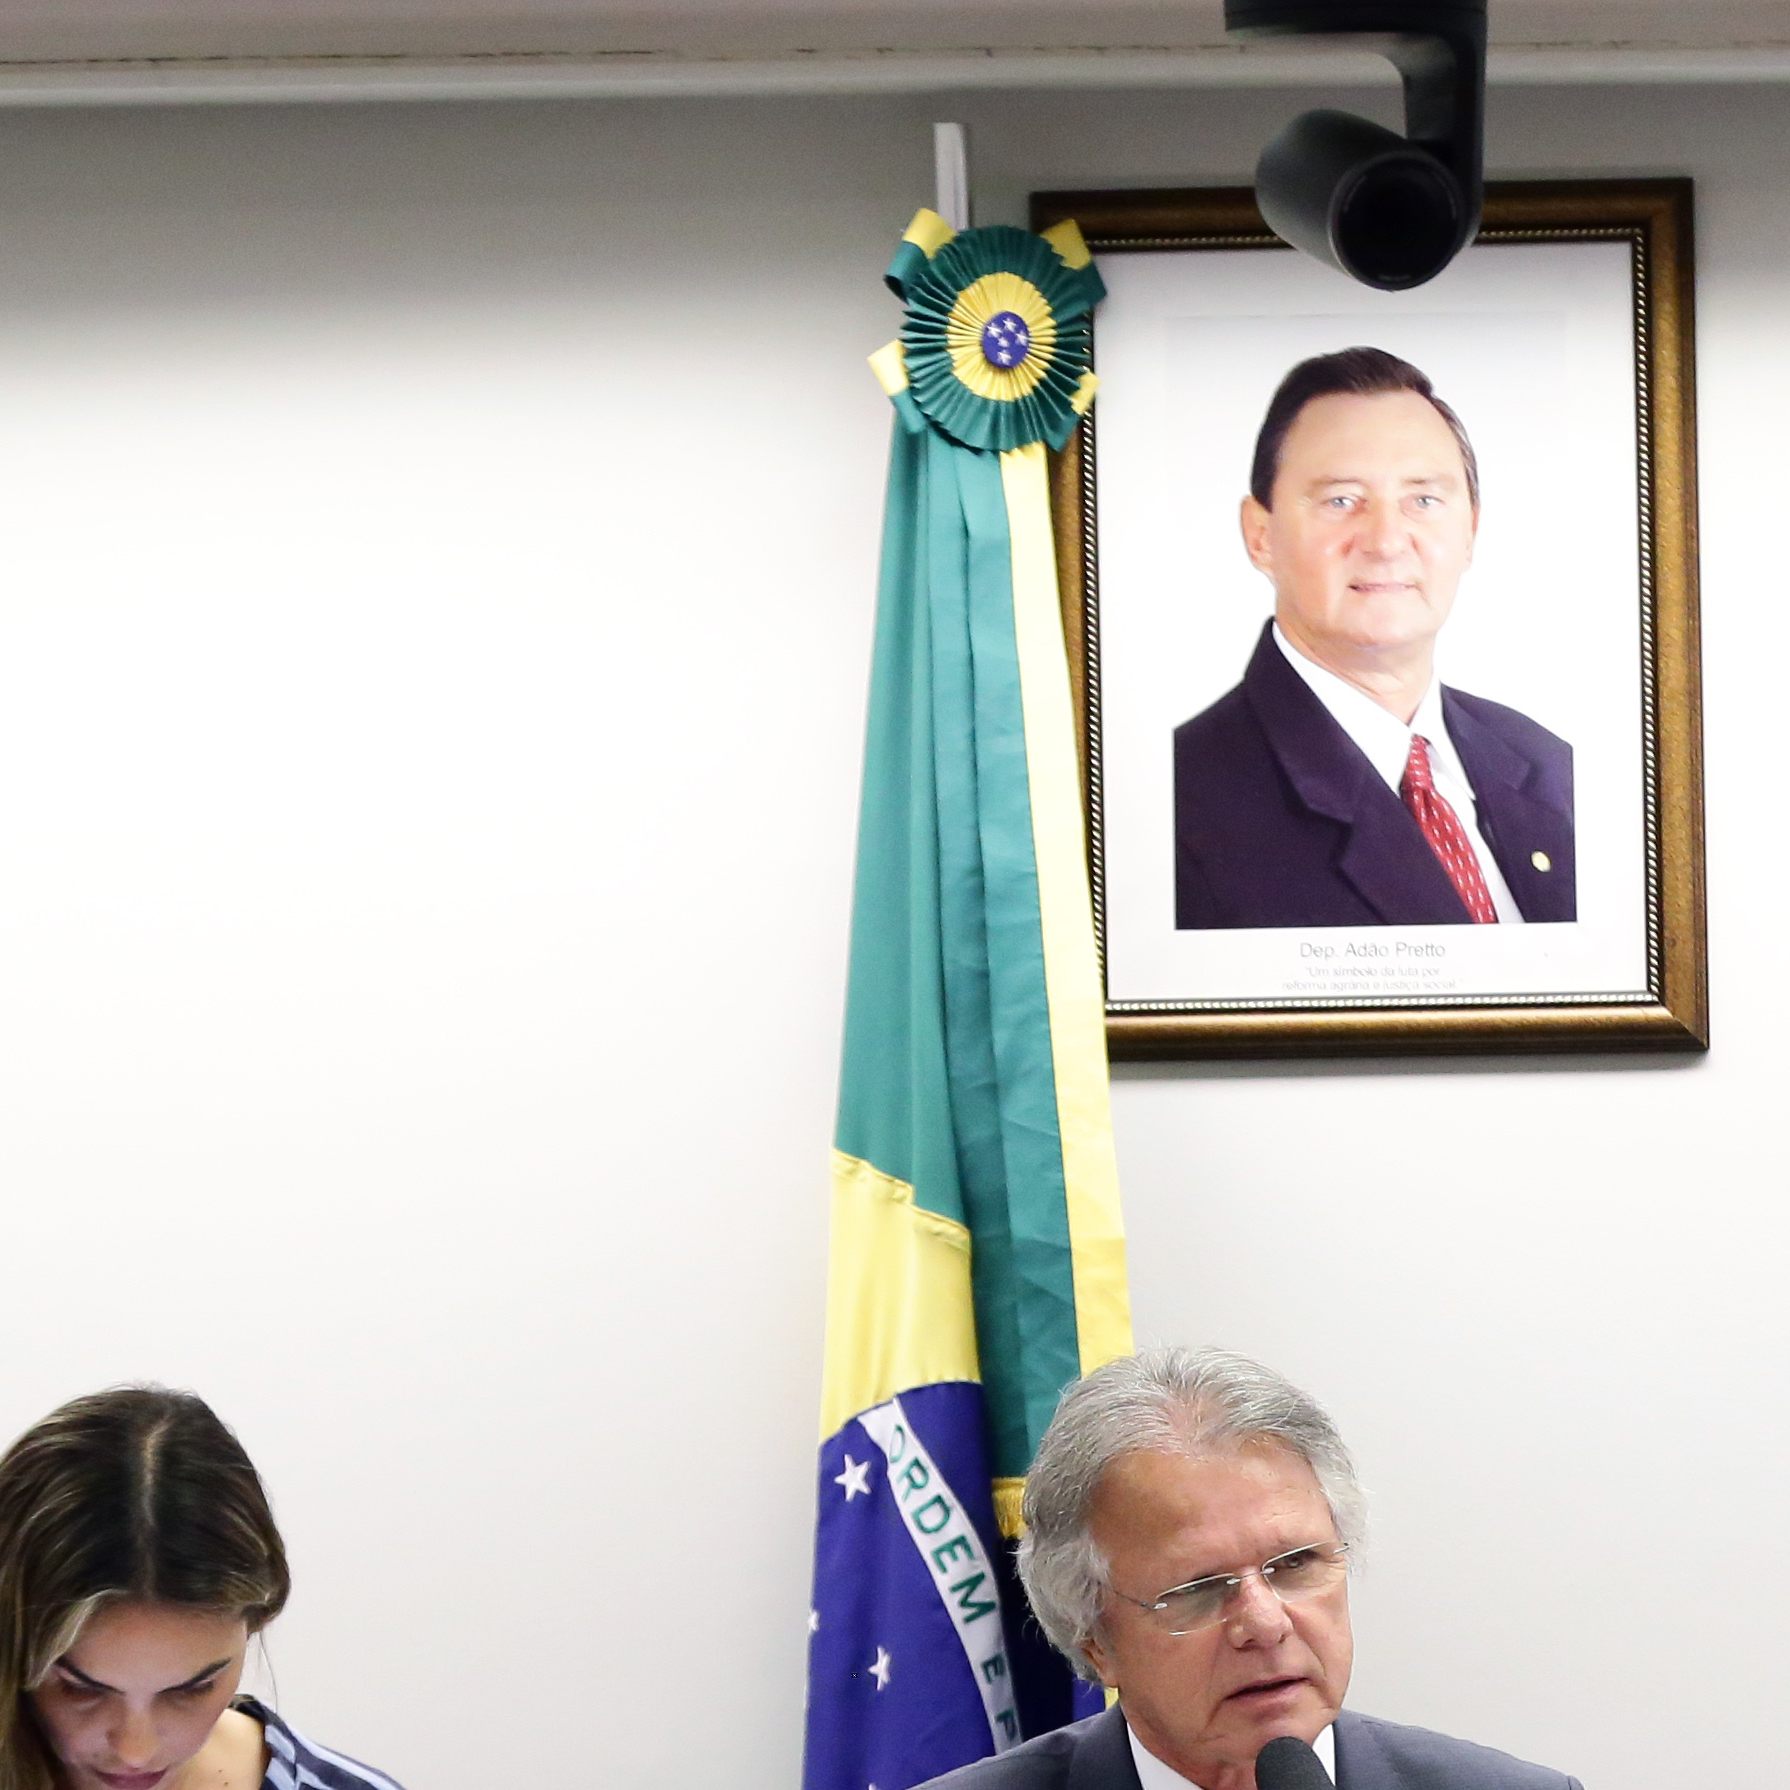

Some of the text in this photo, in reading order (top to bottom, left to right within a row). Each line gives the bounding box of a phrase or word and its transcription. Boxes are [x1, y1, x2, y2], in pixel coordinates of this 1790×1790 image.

[1344, 942, 1389, 958] Adão
[1395, 941, 1446, 958] Pretto
[890, 1424, 1005, 1684] ORDEM E
